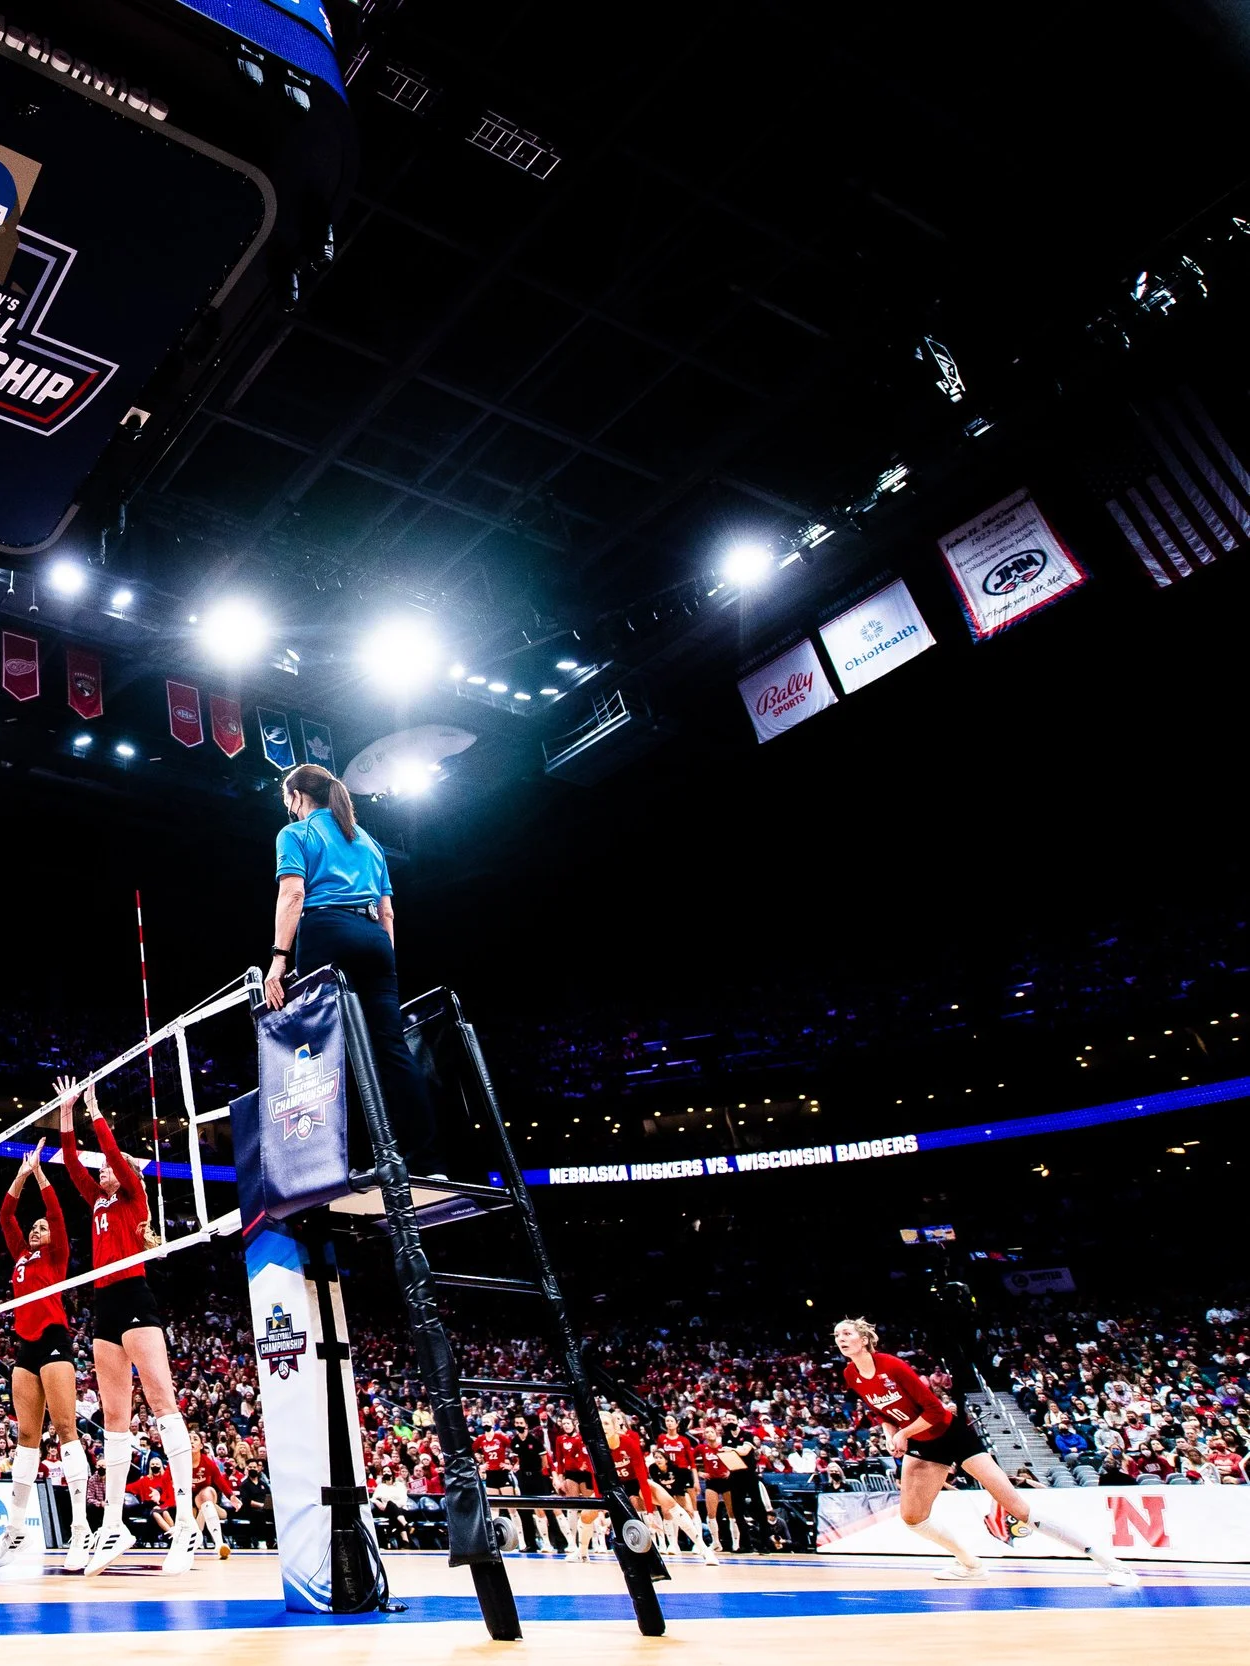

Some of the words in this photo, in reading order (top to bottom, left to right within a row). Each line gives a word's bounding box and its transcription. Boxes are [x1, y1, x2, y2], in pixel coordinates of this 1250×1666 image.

[993, 554, 1041, 591] JHM
[844, 623, 919, 672] OhioHealth
[756, 671, 813, 716] Bally
[772, 692, 806, 718] SPORTS
[275, 1079, 335, 1114] CHAMPIONSHIP
[549, 1164, 629, 1185] NEBRASKA
[630, 1159, 703, 1181] HUSKERS
[705, 1157, 734, 1176] VS.
[735, 1145, 834, 1172] WISCONSIN
[835, 1134, 919, 1162] BADGERS
[94, 1213, 109, 1235] 14
[16, 1265, 25, 1283] 3
[260, 1338, 305, 1354] CHAMPIONSHIP
[886, 1408, 910, 1421] 10
[488, 1452, 498, 1460] 22
[1107, 1494, 1170, 1548] N
